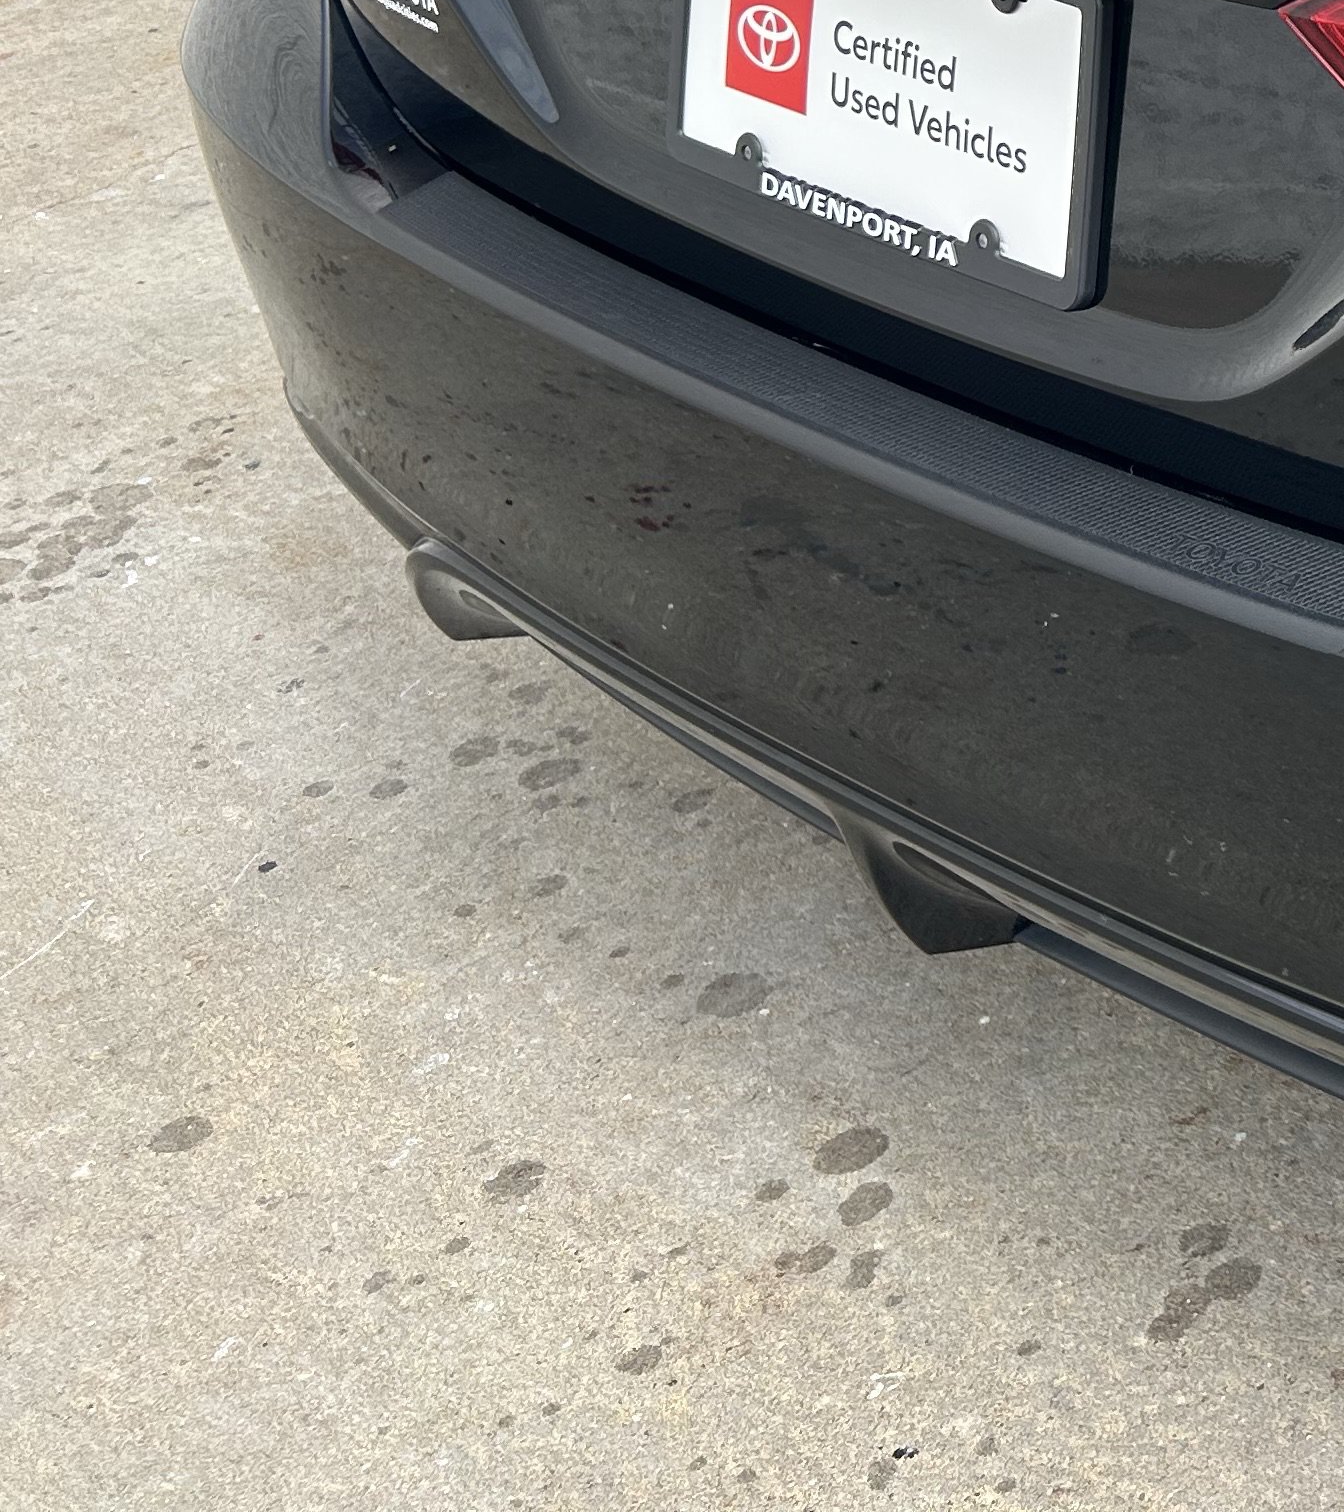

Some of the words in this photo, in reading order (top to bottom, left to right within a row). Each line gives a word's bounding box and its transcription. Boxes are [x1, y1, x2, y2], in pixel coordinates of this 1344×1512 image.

[832, 20, 957, 94] Certified
[830, 73, 901, 139] Used
[908, 106, 1028, 175] Vehicles
[761, 171, 921, 259] DAVENPORT,
[931, 234, 958, 267] IA
[1167, 533, 1304, 594] TOYOTA
